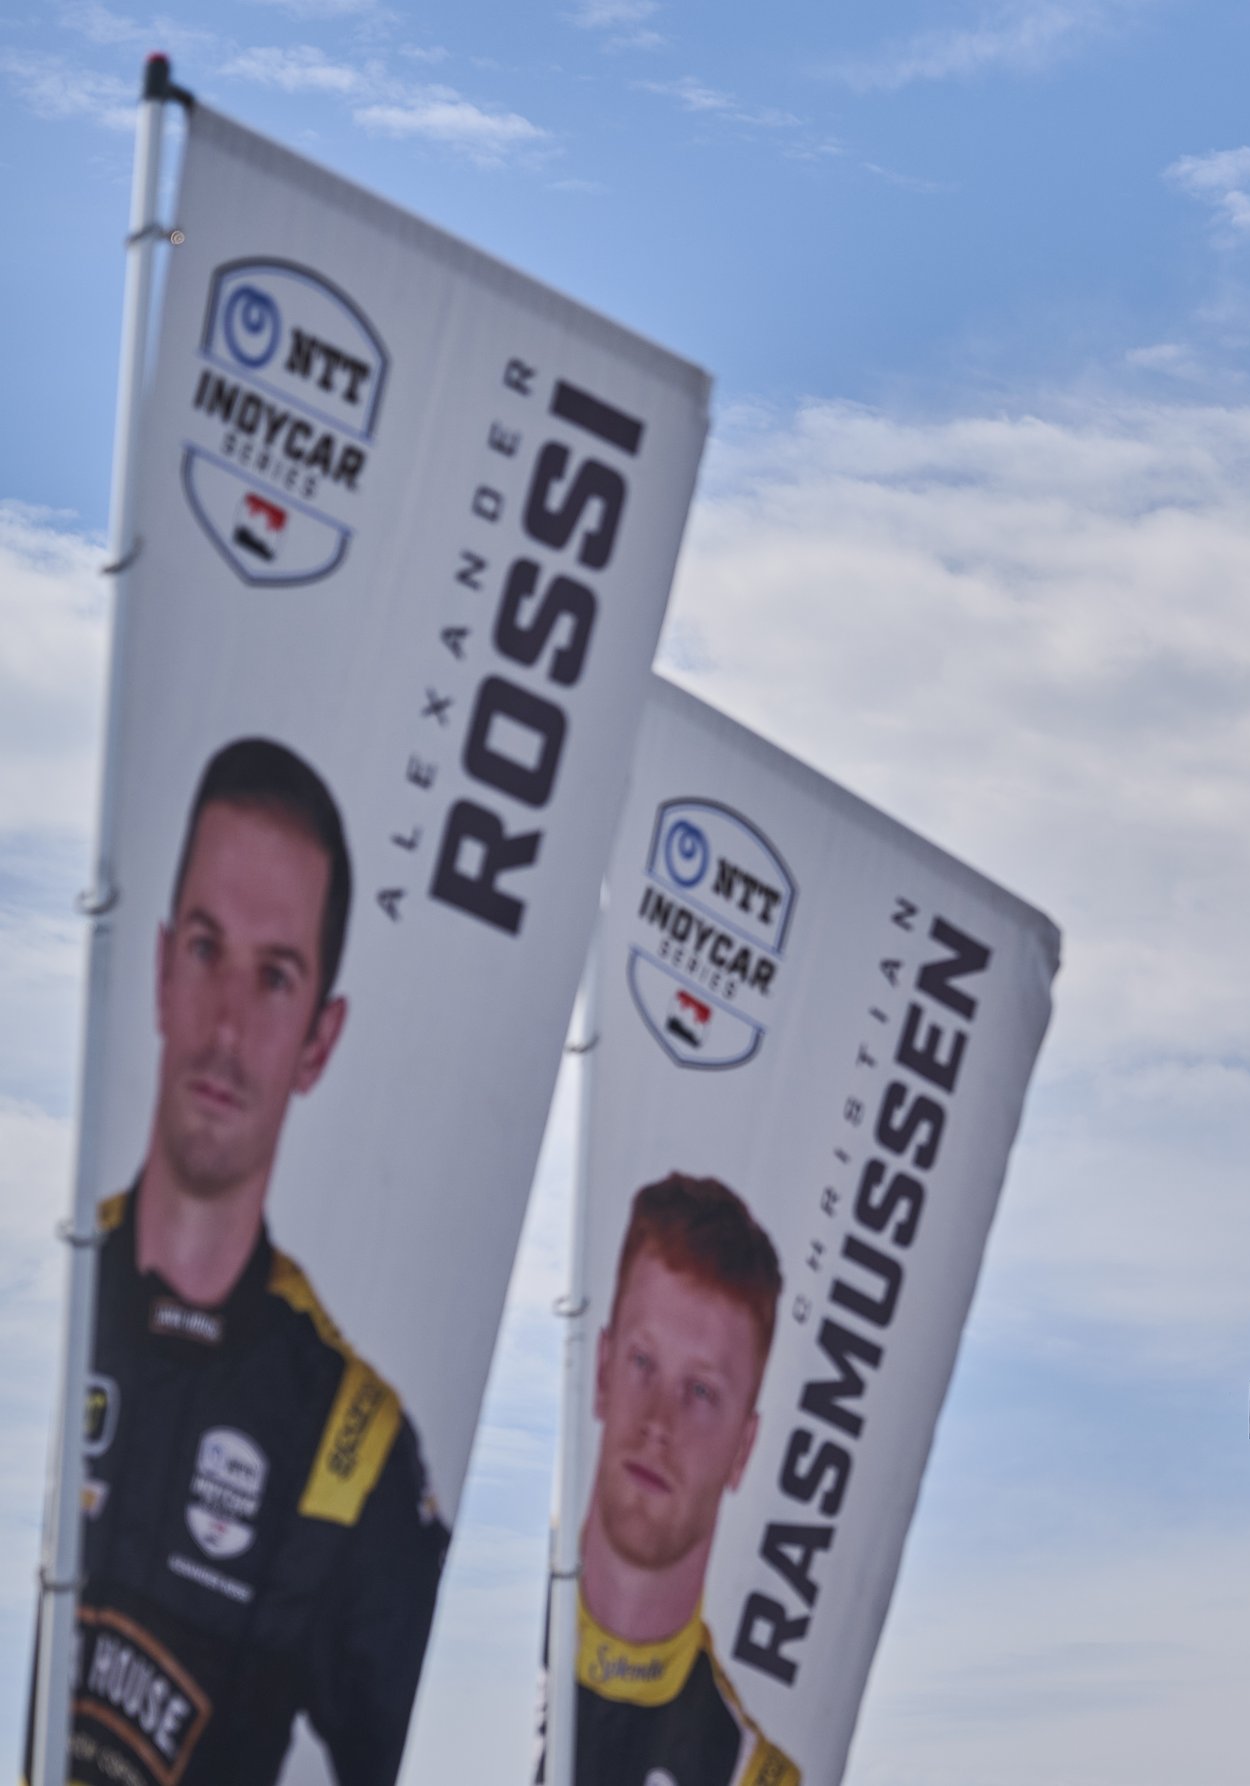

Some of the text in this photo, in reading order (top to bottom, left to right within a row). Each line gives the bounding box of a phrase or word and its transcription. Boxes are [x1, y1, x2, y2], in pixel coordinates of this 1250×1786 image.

[284, 326, 370, 405] NTT
[193, 368, 367, 494] INDYCAR
[376, 358, 536, 922] ALEXANDER
[427, 378, 646, 938] ROSSI
[638, 886, 776, 995] INDYCAR
[712, 857, 782, 925] NTT
[791, 897, 920, 1325] CHRISTIAN
[731, 915, 993, 1688] RASMUSSEN
[88, 1632, 191, 1759] HOUSE
